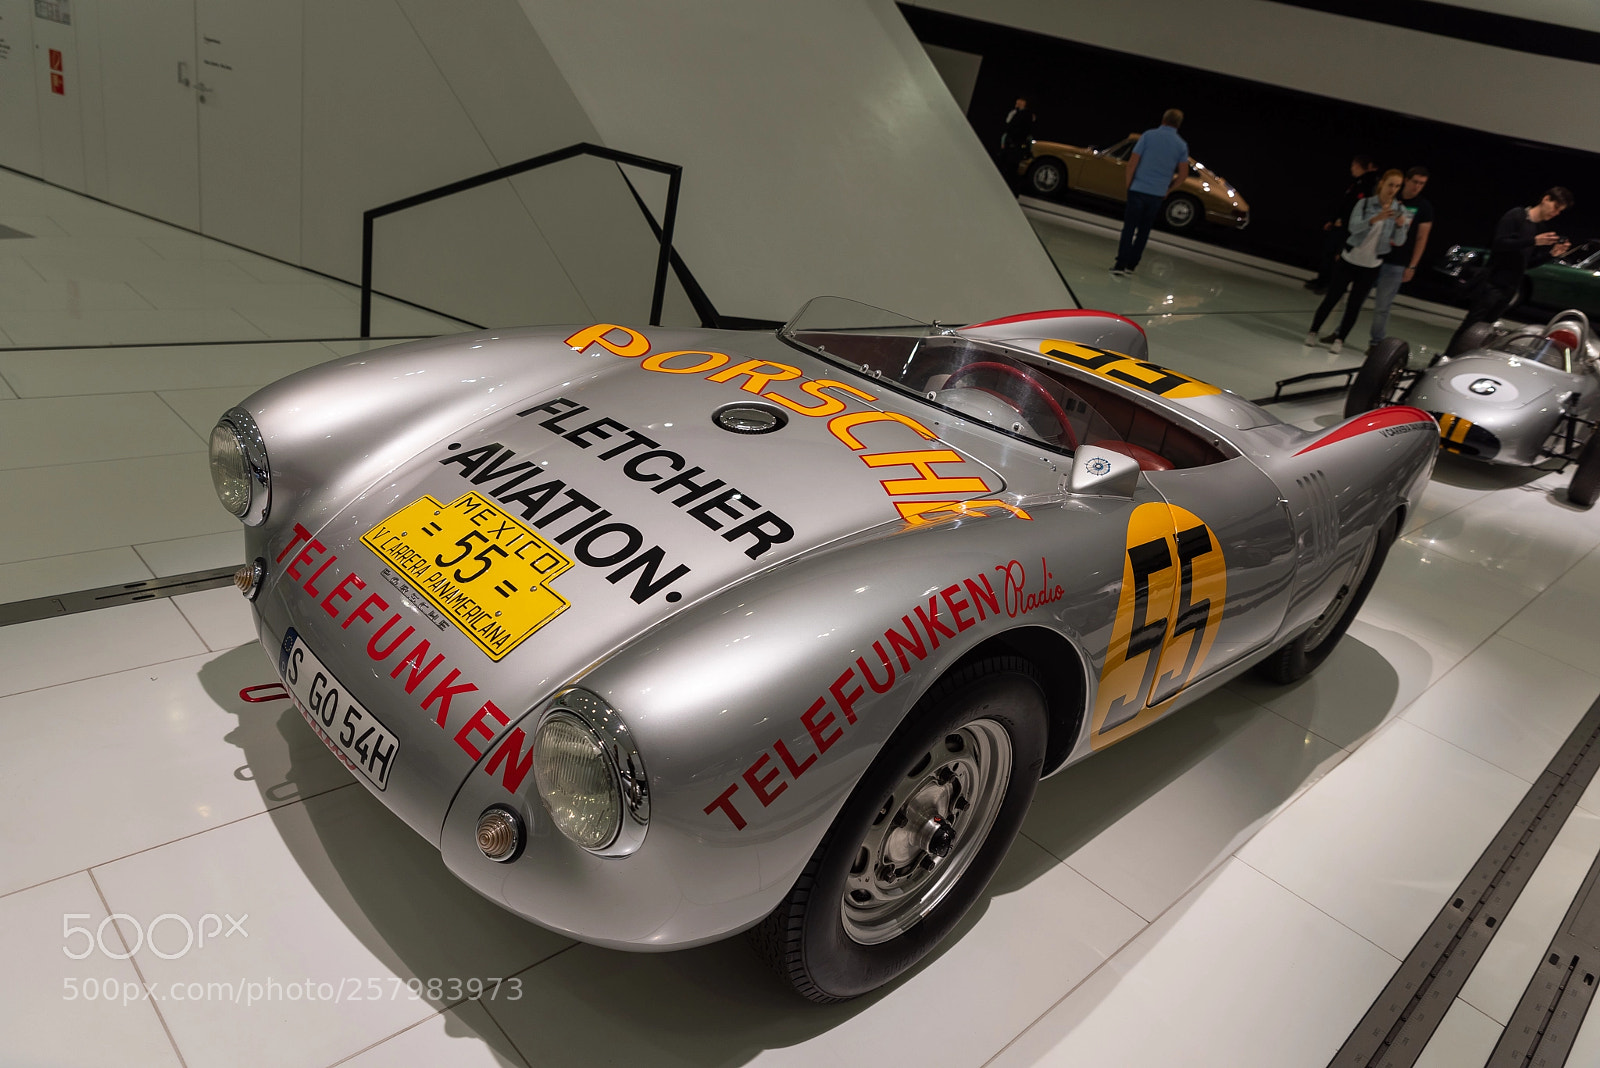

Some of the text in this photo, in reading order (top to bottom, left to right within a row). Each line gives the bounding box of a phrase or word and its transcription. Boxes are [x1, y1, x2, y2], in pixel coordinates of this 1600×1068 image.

[563, 323, 1034, 526] PORSCHE
[1469, 378, 1502, 396] 6
[454, 497, 561, 575] MEXICO
[516, 397, 795, 561] FLETCHER
[371, 526, 512, 650] V CARRERA PANAMERICANA
[434, 529, 510, 584] 55
[1098, 524, 1213, 736] 55
[276, 522, 535, 795] TELEFUNKEN
[288, 647, 304, 686] S
[308, 671, 339, 728] GO
[339, 704, 395, 784] 54H
[703, 557, 1064, 831] TELEFUNKEN Radio
